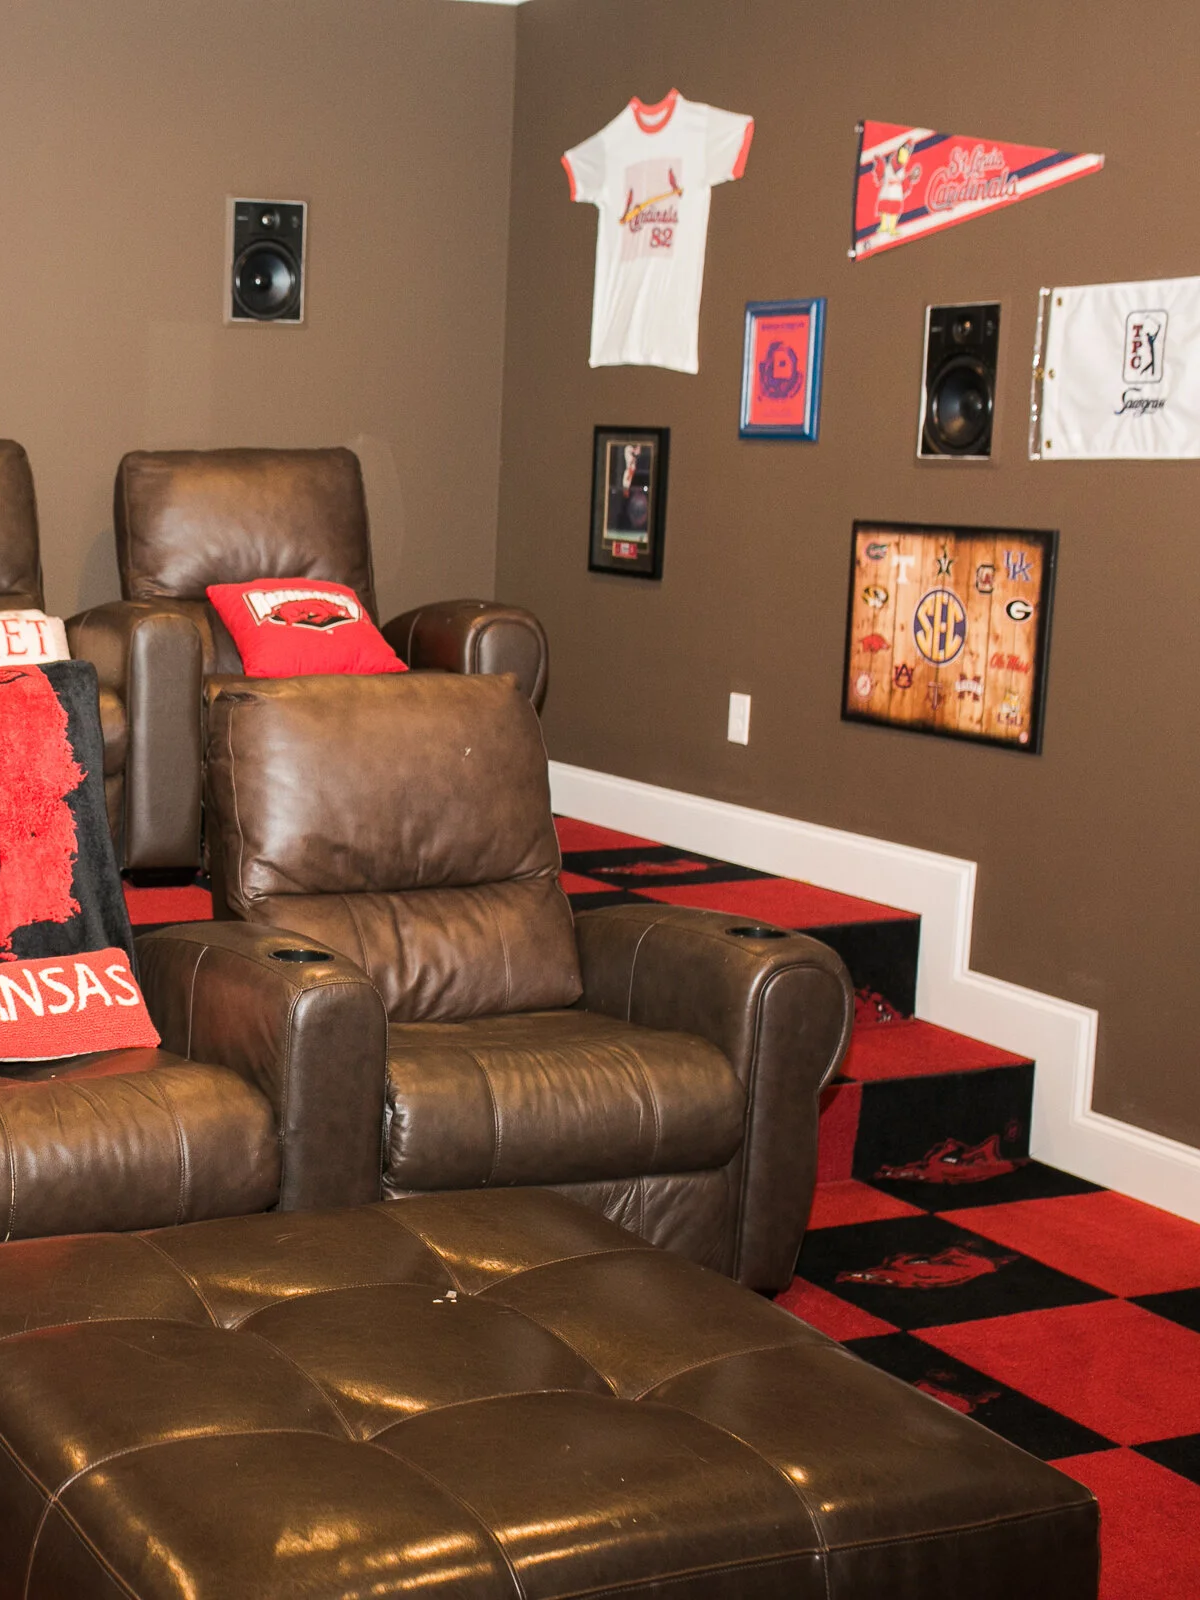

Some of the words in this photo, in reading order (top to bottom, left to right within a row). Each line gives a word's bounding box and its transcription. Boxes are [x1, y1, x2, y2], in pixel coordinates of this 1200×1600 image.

[925, 167, 1019, 213] Cardinals
[650, 227, 673, 248] 82
[1003, 550, 1031, 582] UK
[915, 591, 965, 662] SEC
